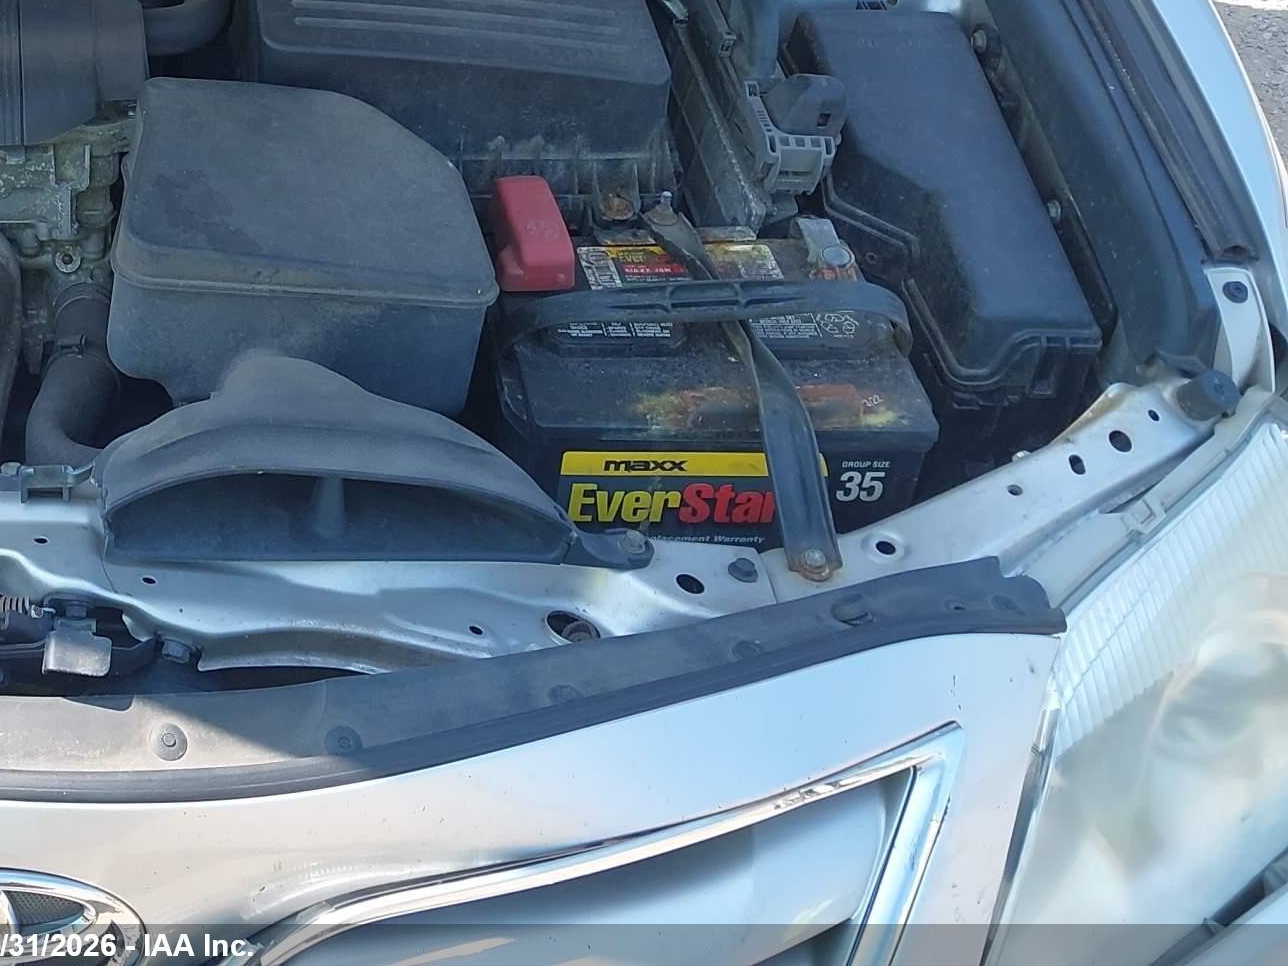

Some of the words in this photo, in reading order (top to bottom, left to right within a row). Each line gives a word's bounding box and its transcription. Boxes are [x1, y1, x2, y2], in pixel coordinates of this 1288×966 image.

[603, 459, 688, 472] maxx
[841, 460, 871, 469] GROUP
[872, 460, 891, 468] SIZE
[835, 471, 886, 502] 35
[567, 482, 776, 523] EverStar
[714, 535, 765, 544] Warranty
